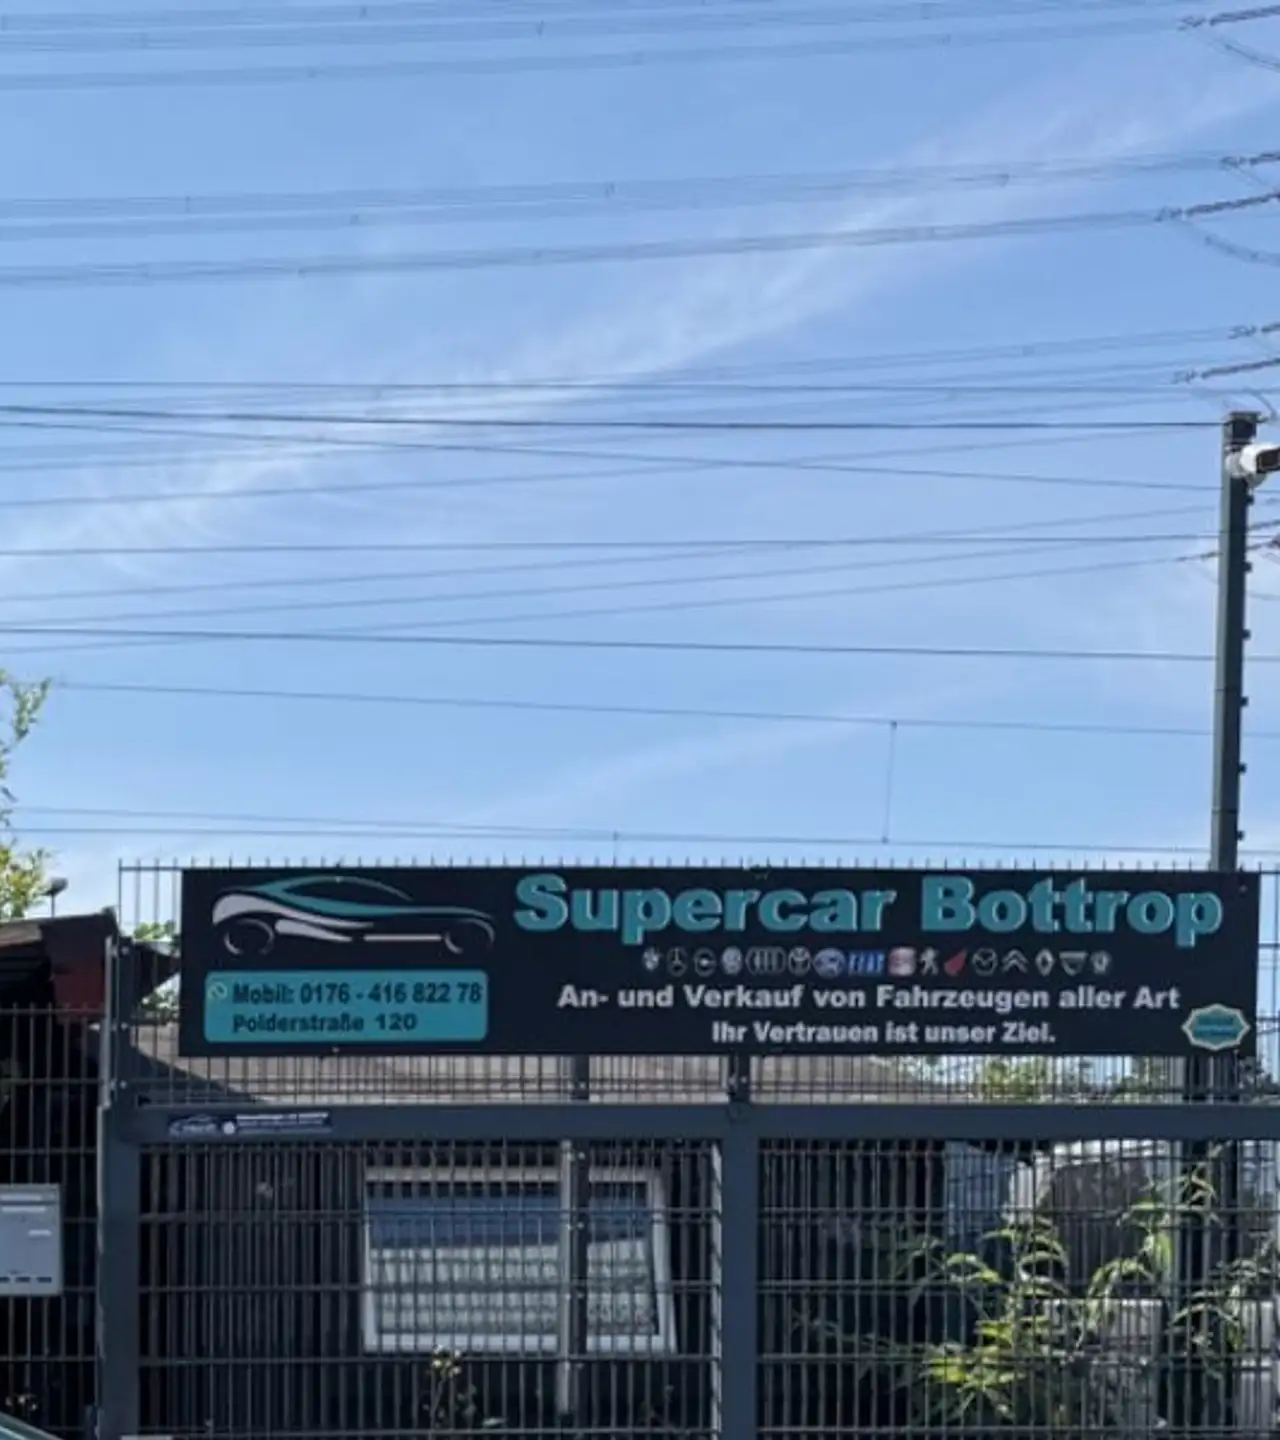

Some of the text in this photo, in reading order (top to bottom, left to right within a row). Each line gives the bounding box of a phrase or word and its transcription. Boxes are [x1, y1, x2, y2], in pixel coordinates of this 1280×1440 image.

[514, 873, 1224, 948] Supercar Bottrop
[299, 983, 351, 1005] 0176
[412, 983, 451, 1004] 822
[457, 983, 482, 1004] 78
[557, 984, 1180, 1014] An- und Verkauf von Fahrzeugen aller Art
[375, 1013, 418, 1031] 120
[712, 1021, 1057, 1044] Ihr Vertrauen ist unser Ziel.
